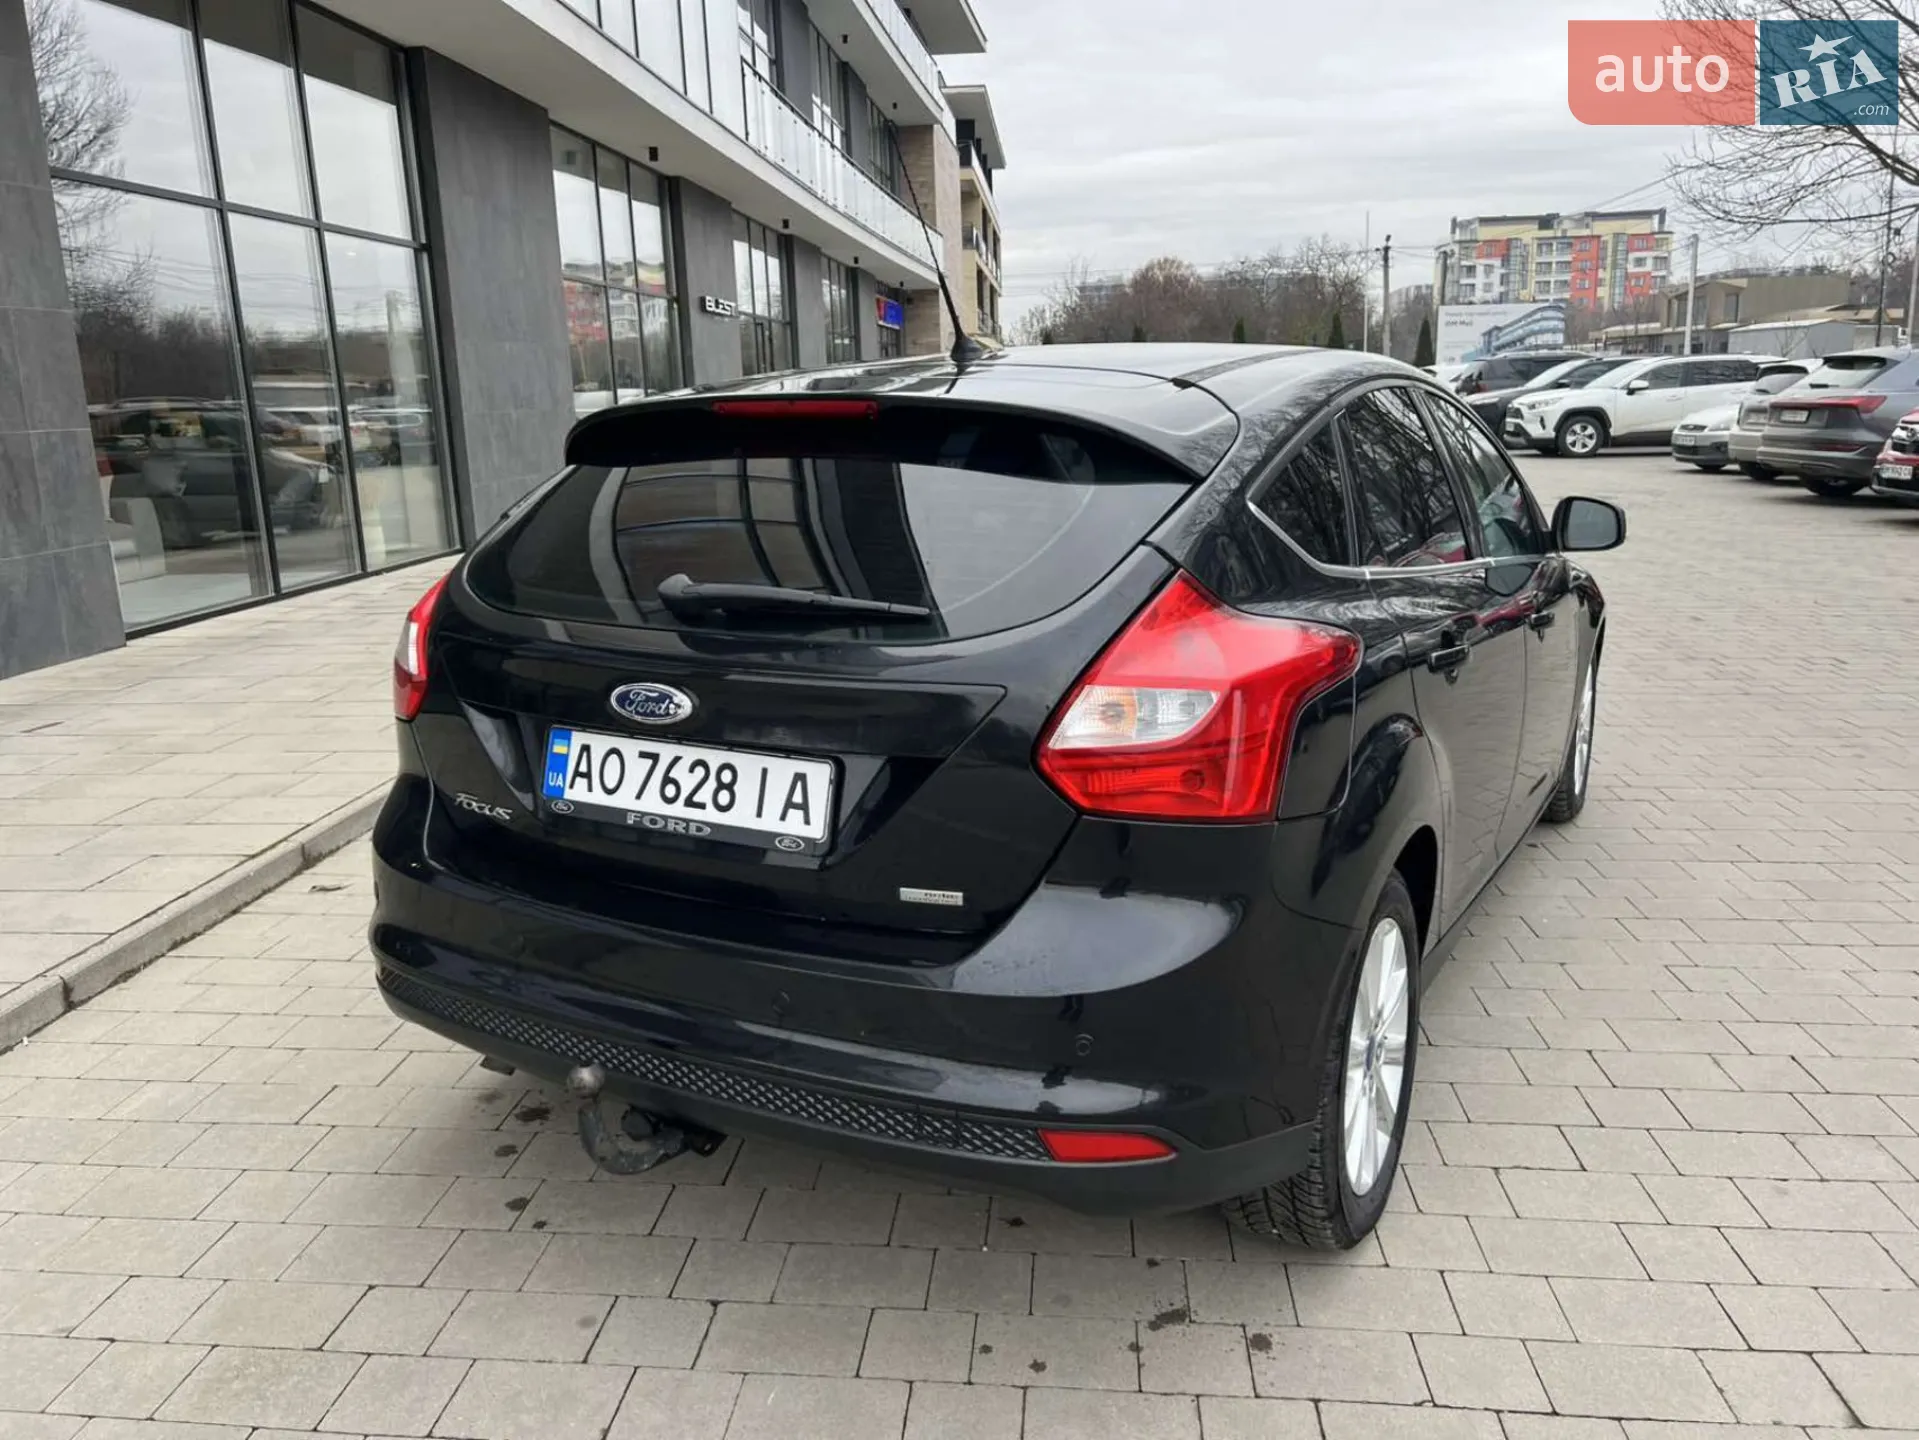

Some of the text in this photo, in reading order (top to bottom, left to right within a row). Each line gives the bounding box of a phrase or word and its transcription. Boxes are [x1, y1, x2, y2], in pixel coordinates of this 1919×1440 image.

[625, 689, 668, 716] Ford
[548, 771, 564, 788] UA
[625, 811, 712, 837] FORD
